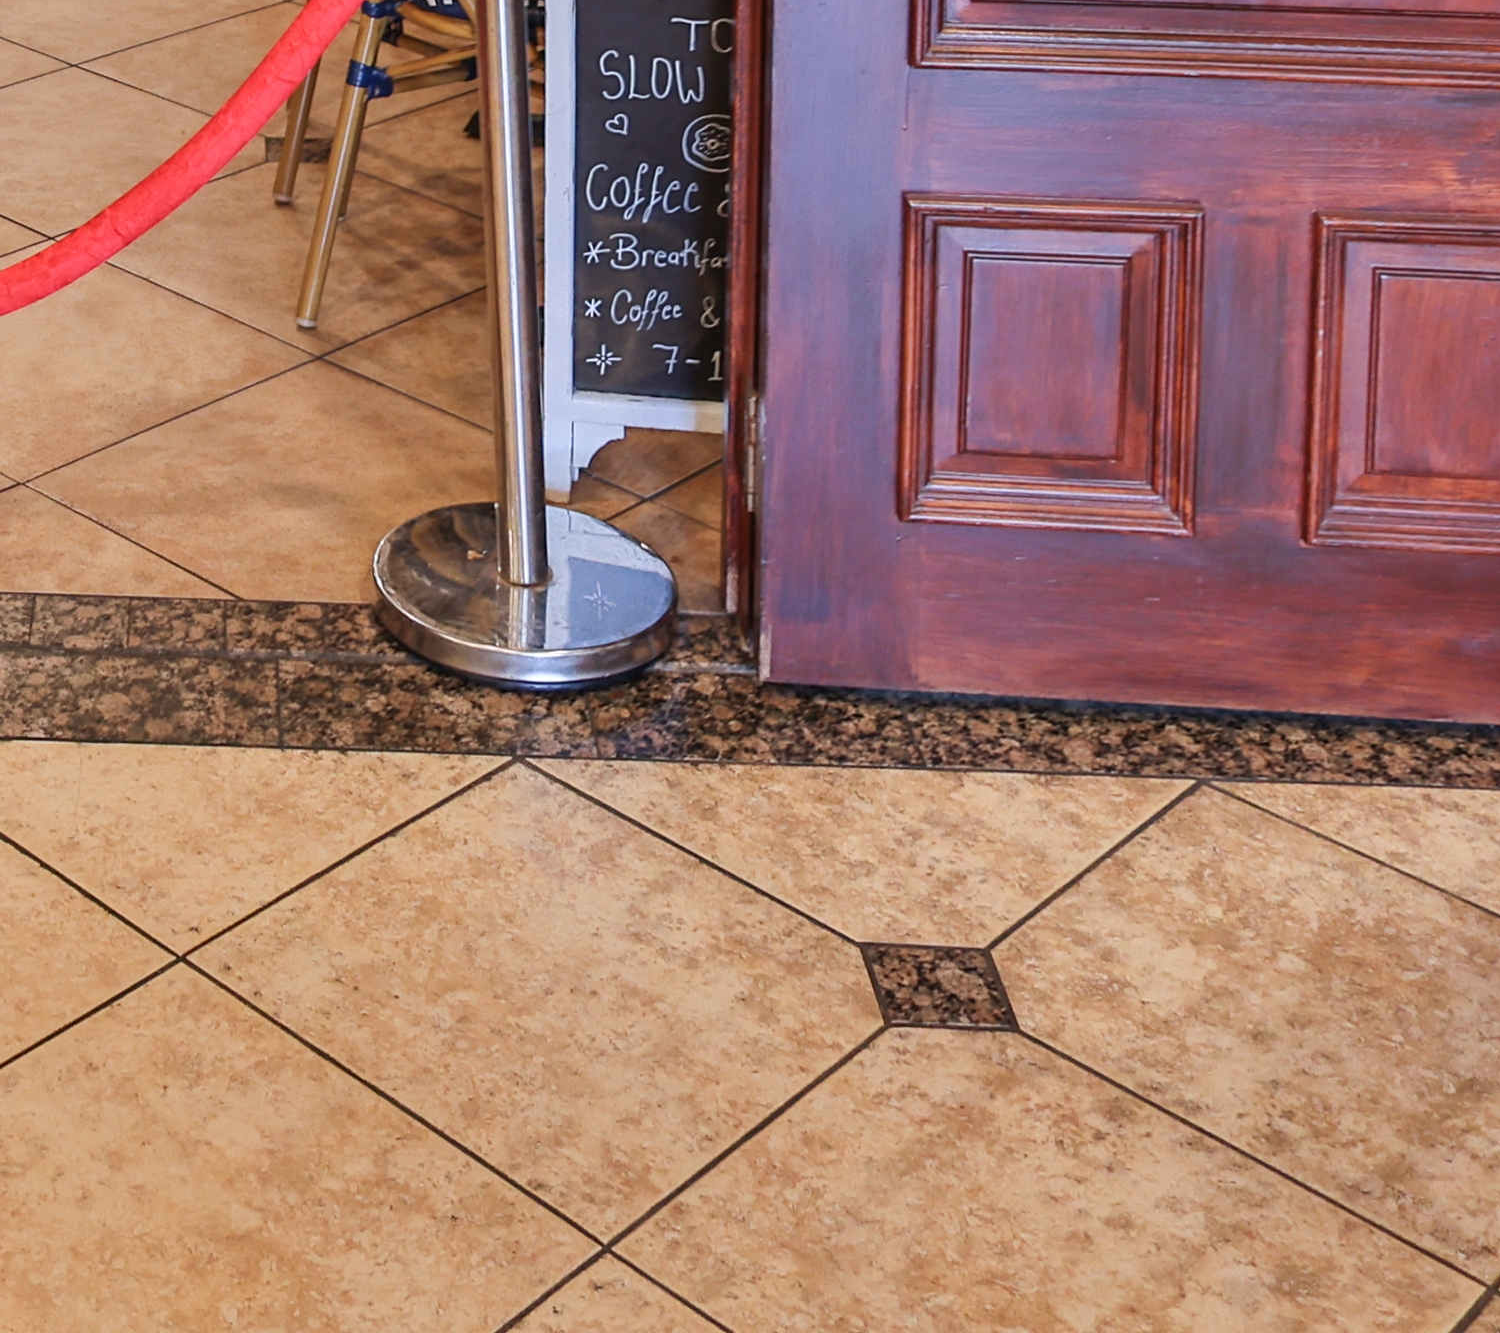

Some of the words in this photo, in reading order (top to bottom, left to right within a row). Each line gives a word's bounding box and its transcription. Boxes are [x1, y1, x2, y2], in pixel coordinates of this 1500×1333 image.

[599, 50, 706, 104] SLOW
[585, 162, 702, 224] Coffee
[609, 233, 729, 276] Breakfa
[610, 289, 683, 331] Coffee
[700, 296, 721, 328] &
